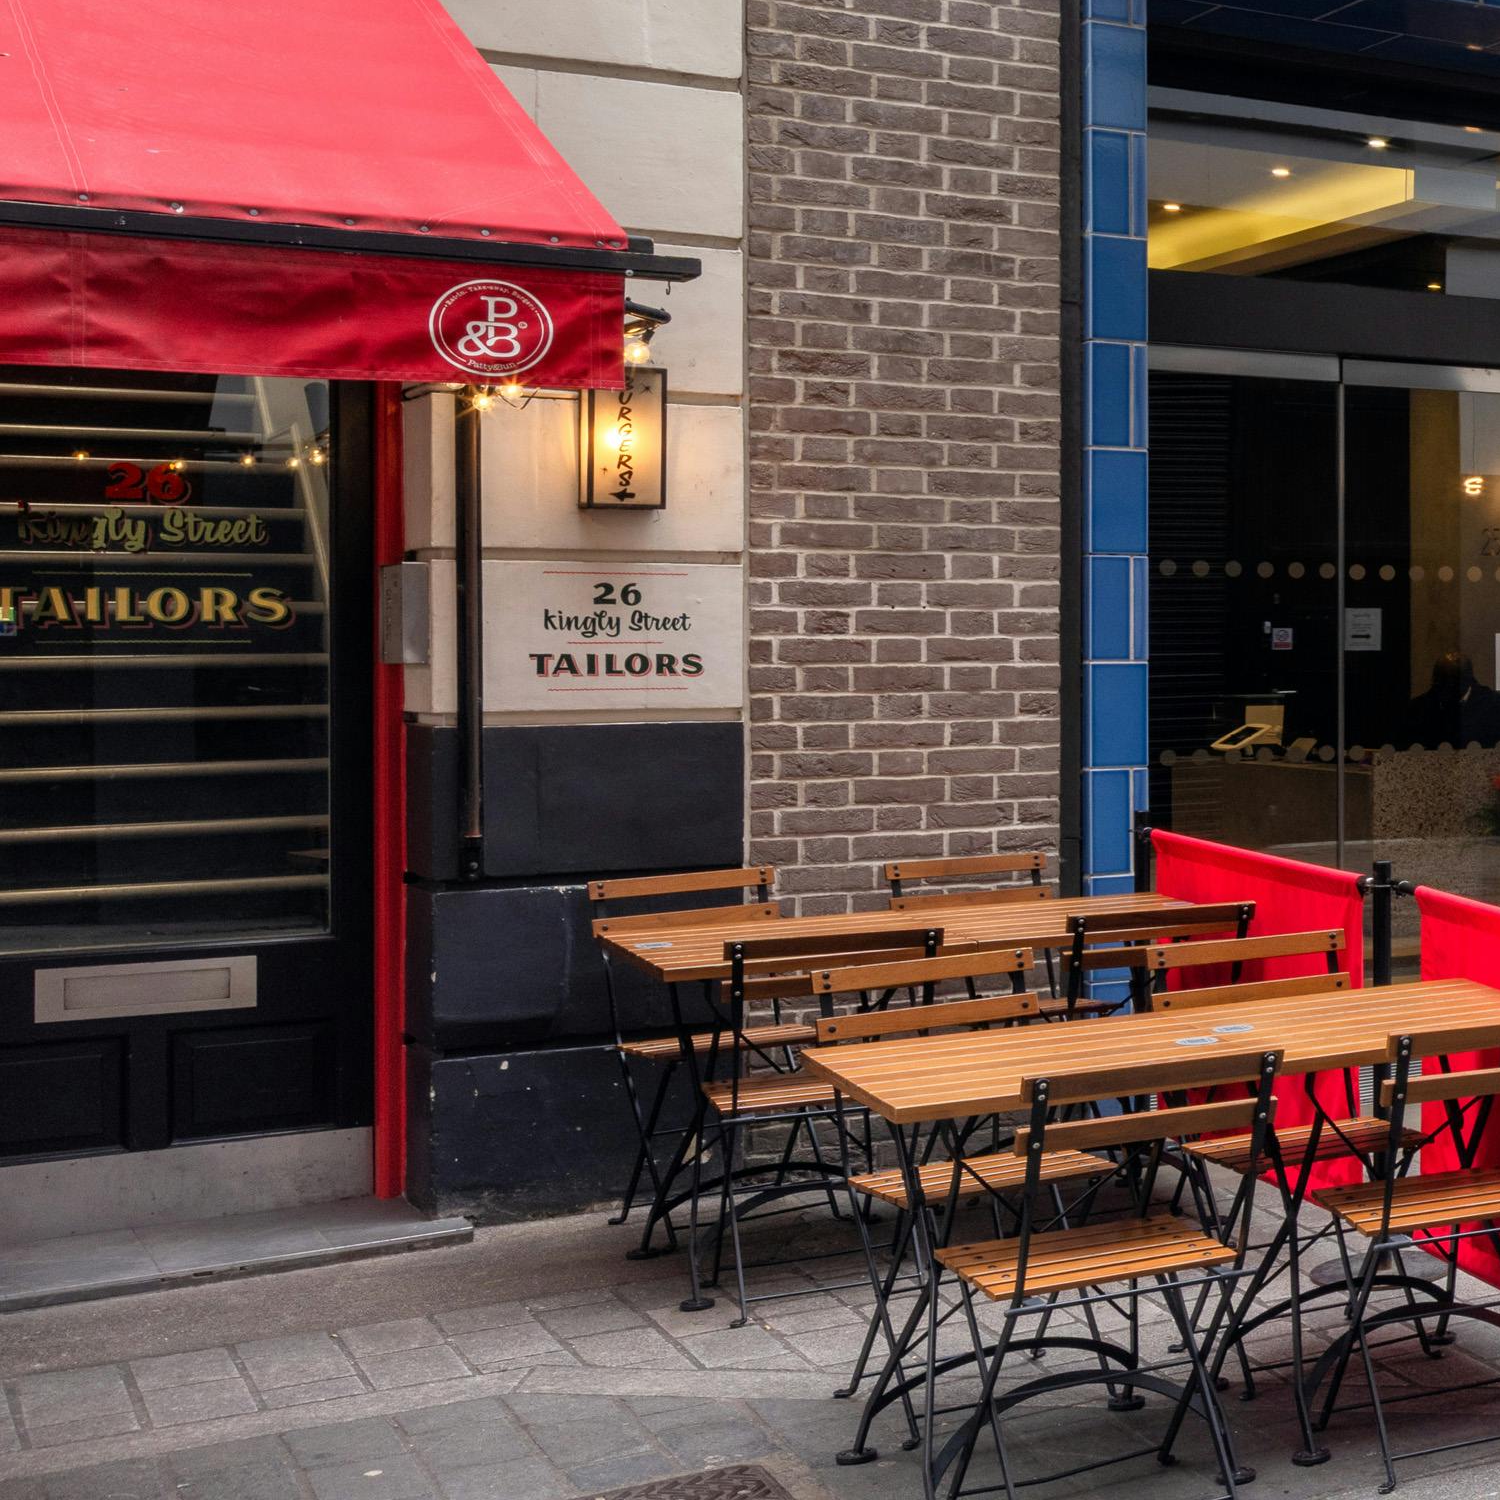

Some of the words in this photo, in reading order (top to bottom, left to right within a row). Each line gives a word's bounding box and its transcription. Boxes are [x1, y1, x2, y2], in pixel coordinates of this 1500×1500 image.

[104, 461, 193, 506] 26
[159, 507, 271, 546] Street
[592, 582, 642, 606] 26
[629, 609, 692, 632] Street
[528, 652, 706, 678] TAILORS
